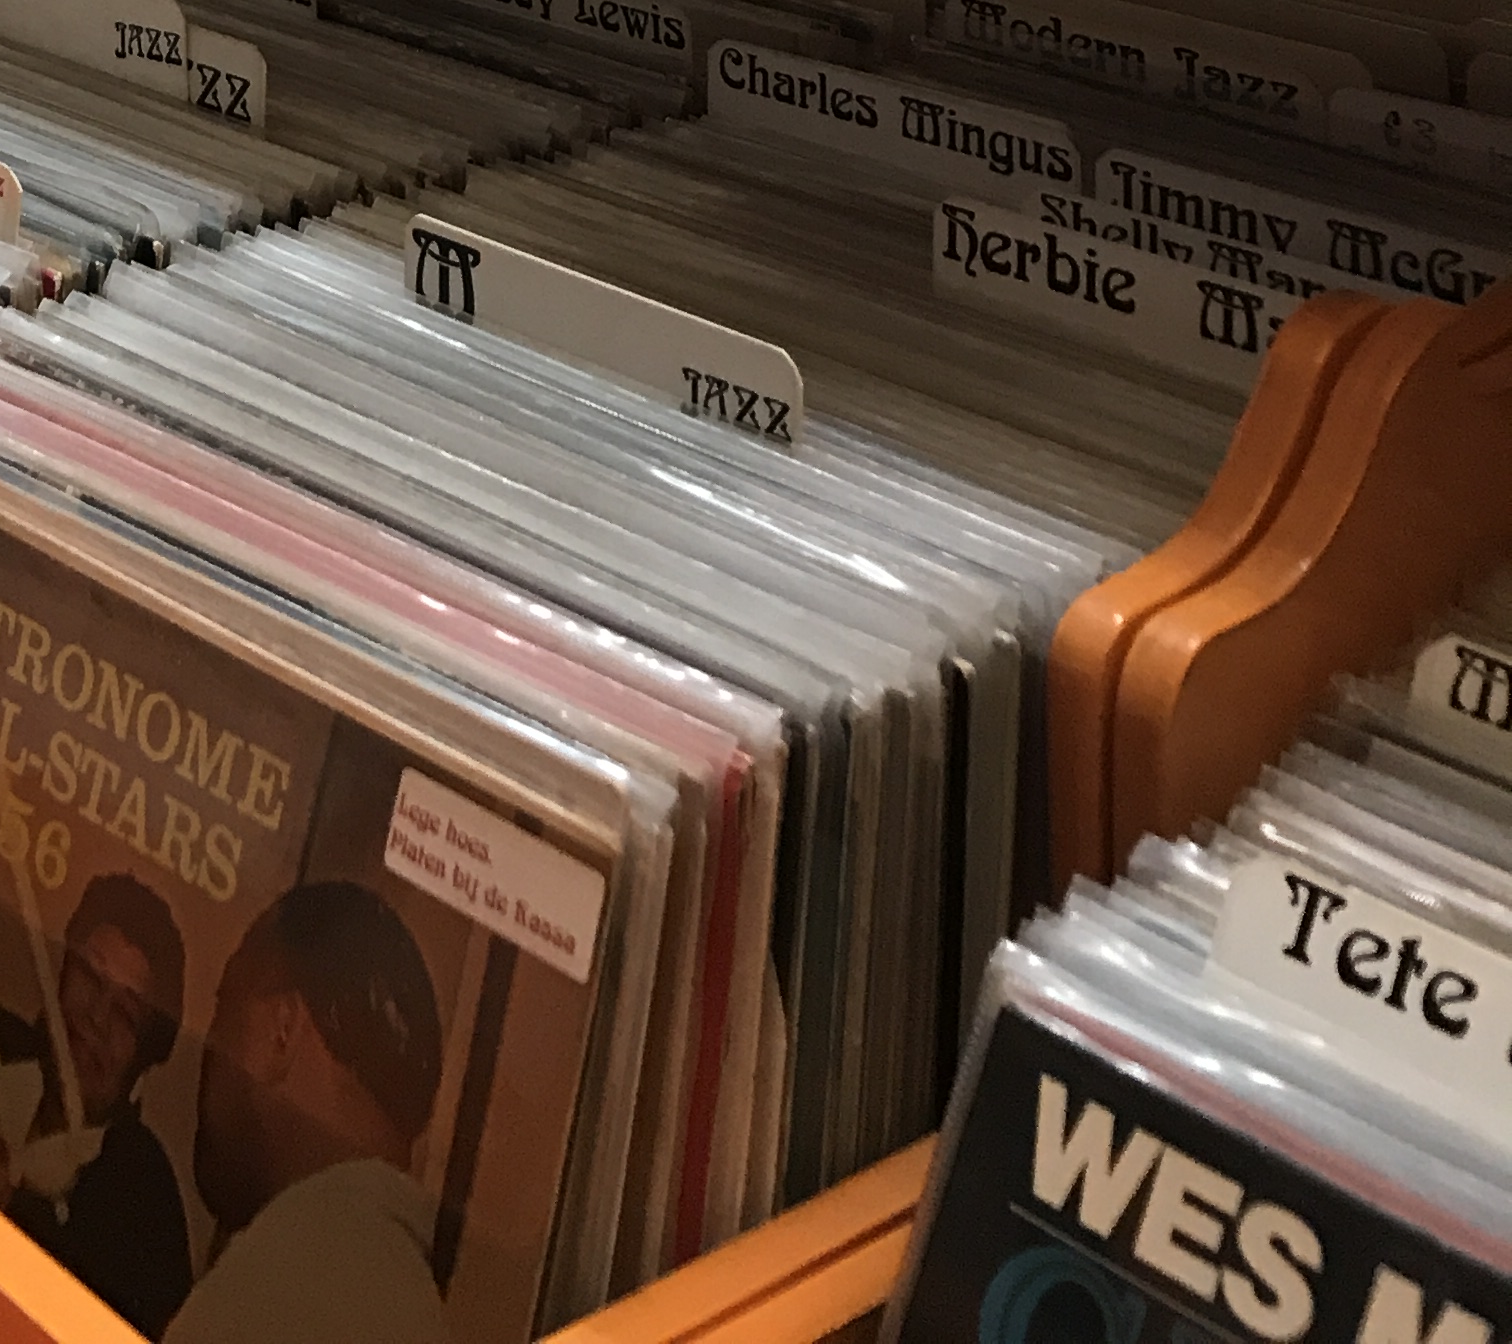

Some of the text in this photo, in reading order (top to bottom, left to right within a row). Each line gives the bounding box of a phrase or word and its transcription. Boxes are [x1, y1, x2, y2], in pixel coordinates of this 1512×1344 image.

[114, 20, 182, 66] JAZZ
[718, 45, 1075, 184] Charles Mingus
[940, 201, 1138, 315] Herbie
[1109, 159, 1299, 257] Jimmy
[681, 365, 794, 444] JAZZ
[397, 791, 443, 837] Lege
[389, 825, 577, 957] Platen bij de Kassa
[1282, 872, 1478, 1040] Tete
[1031, 1073, 1326, 1344] WES
